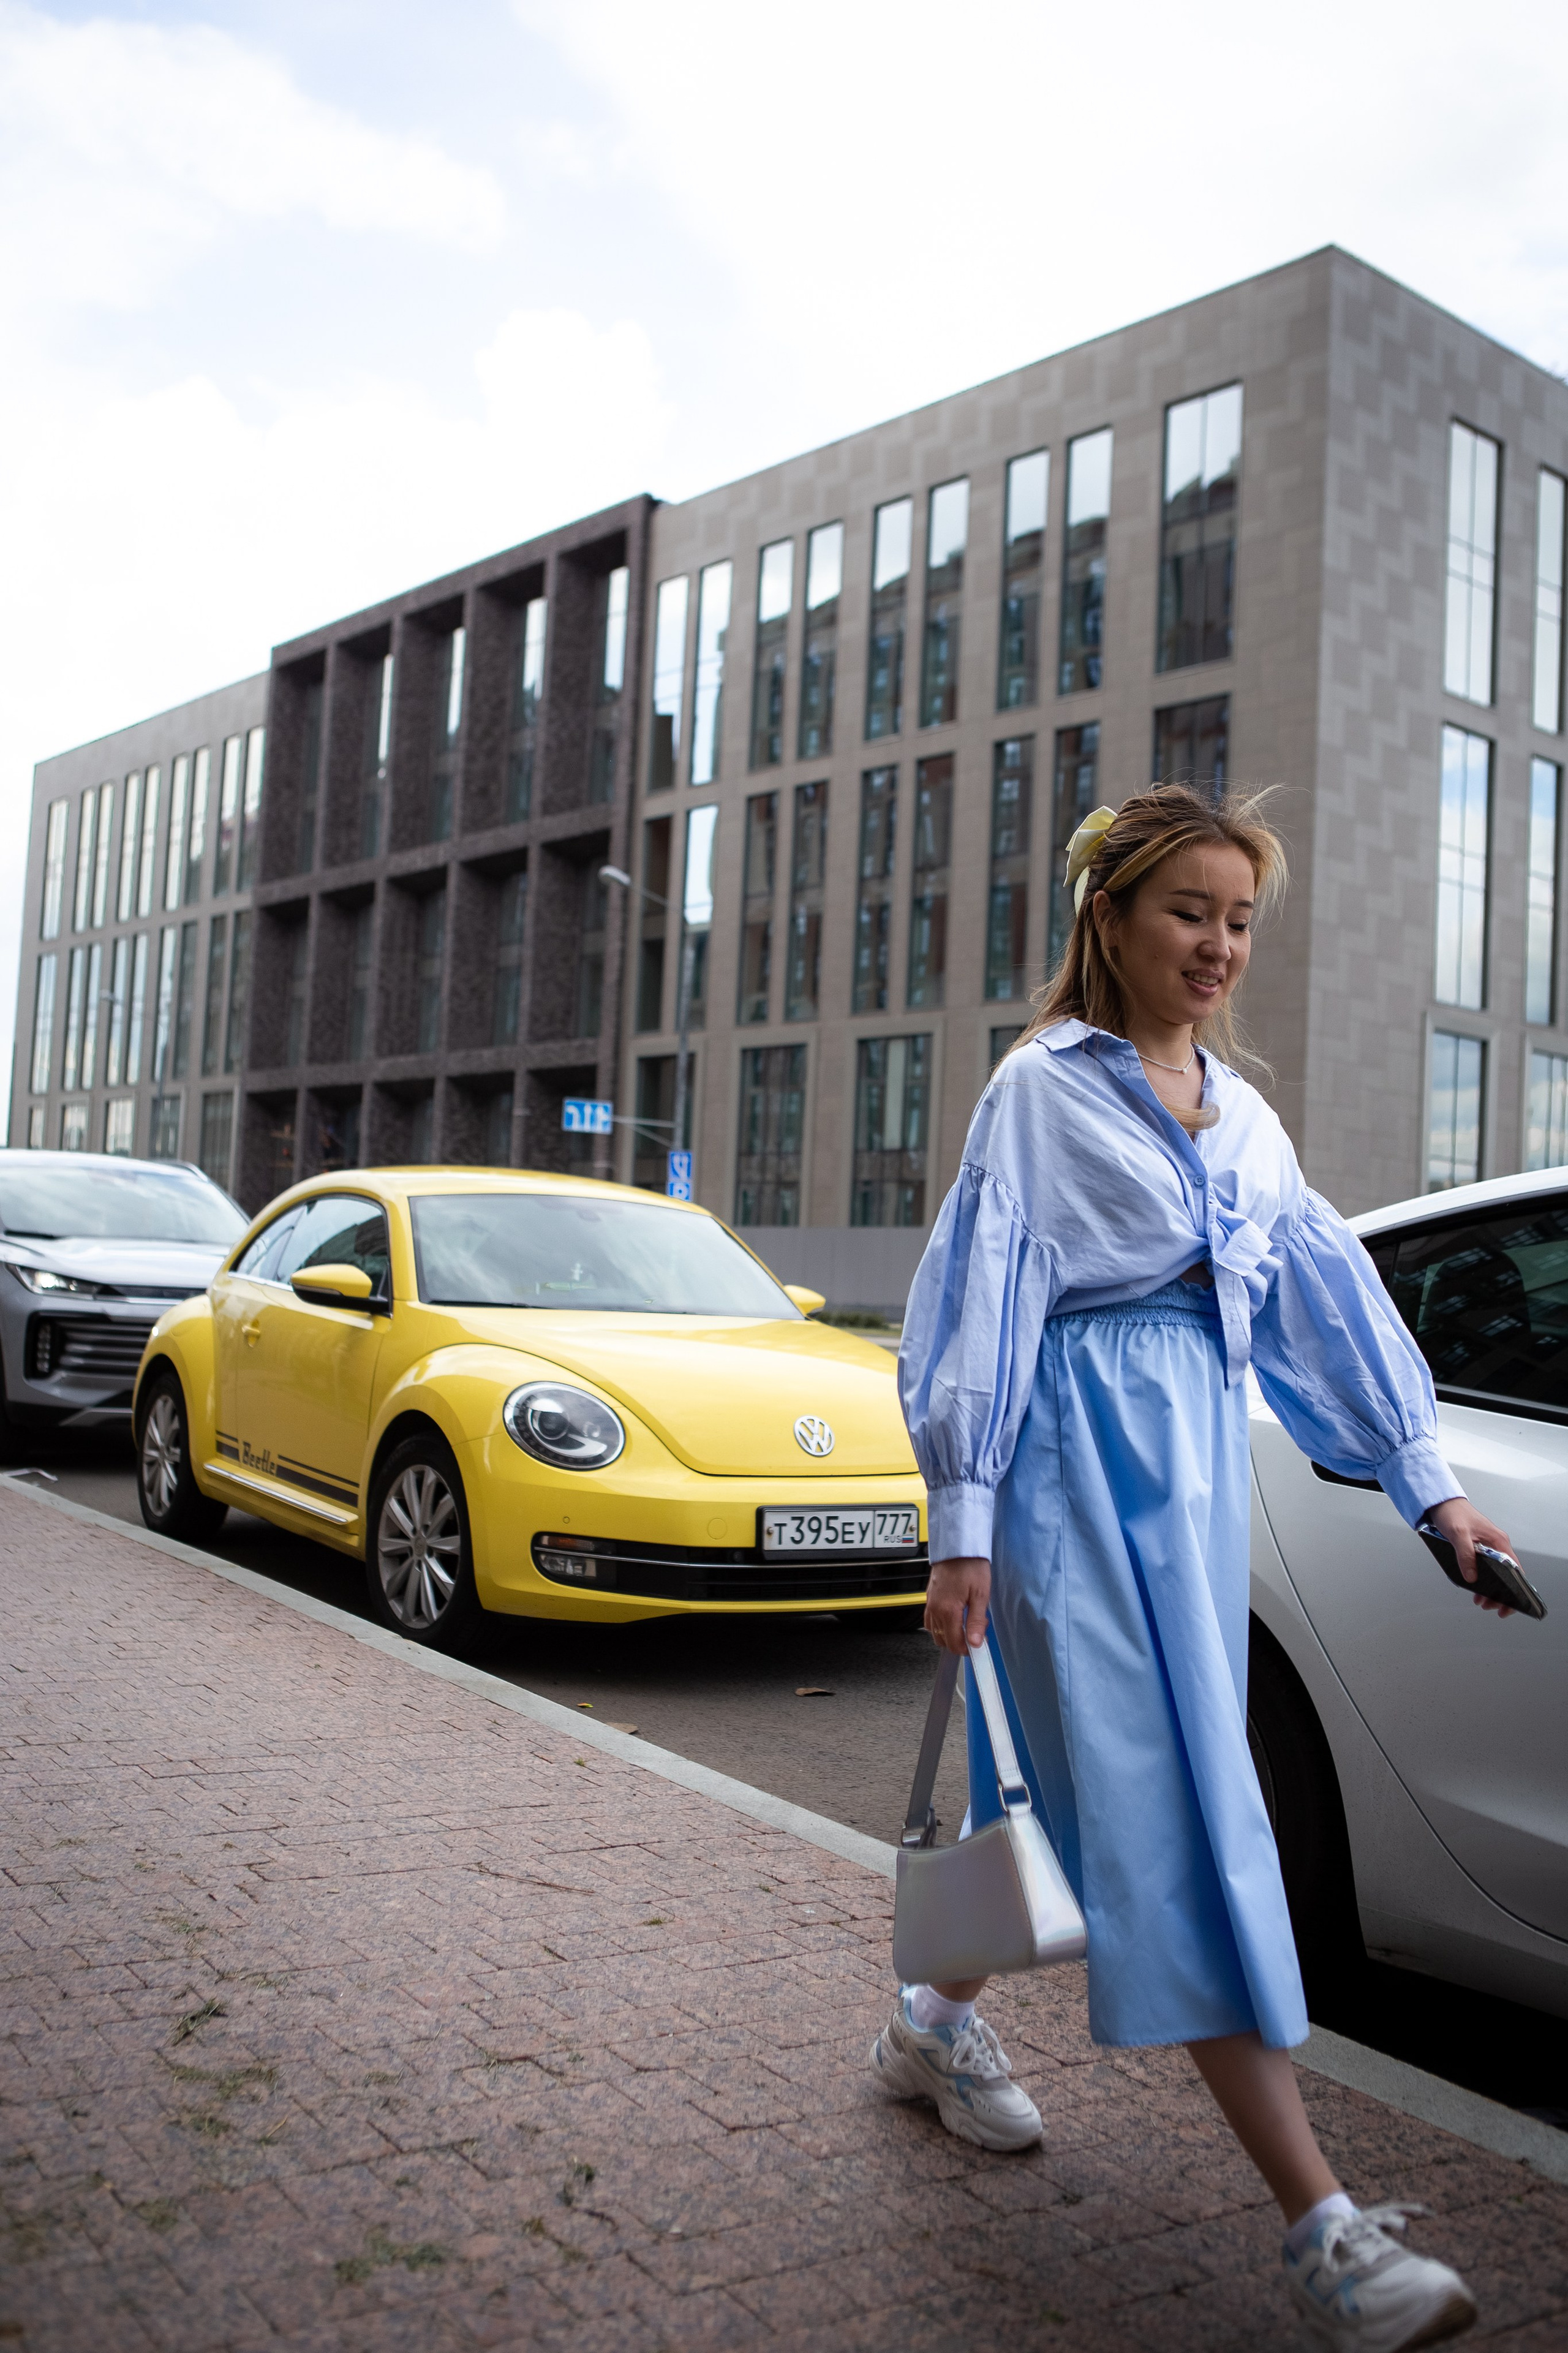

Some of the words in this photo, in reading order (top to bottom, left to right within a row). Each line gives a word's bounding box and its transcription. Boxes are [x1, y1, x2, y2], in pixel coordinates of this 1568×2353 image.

[794, 1415, 835, 1457] VW
[242, 1441, 276, 1475] Beetle
[876, 1513, 912, 1535] 777
